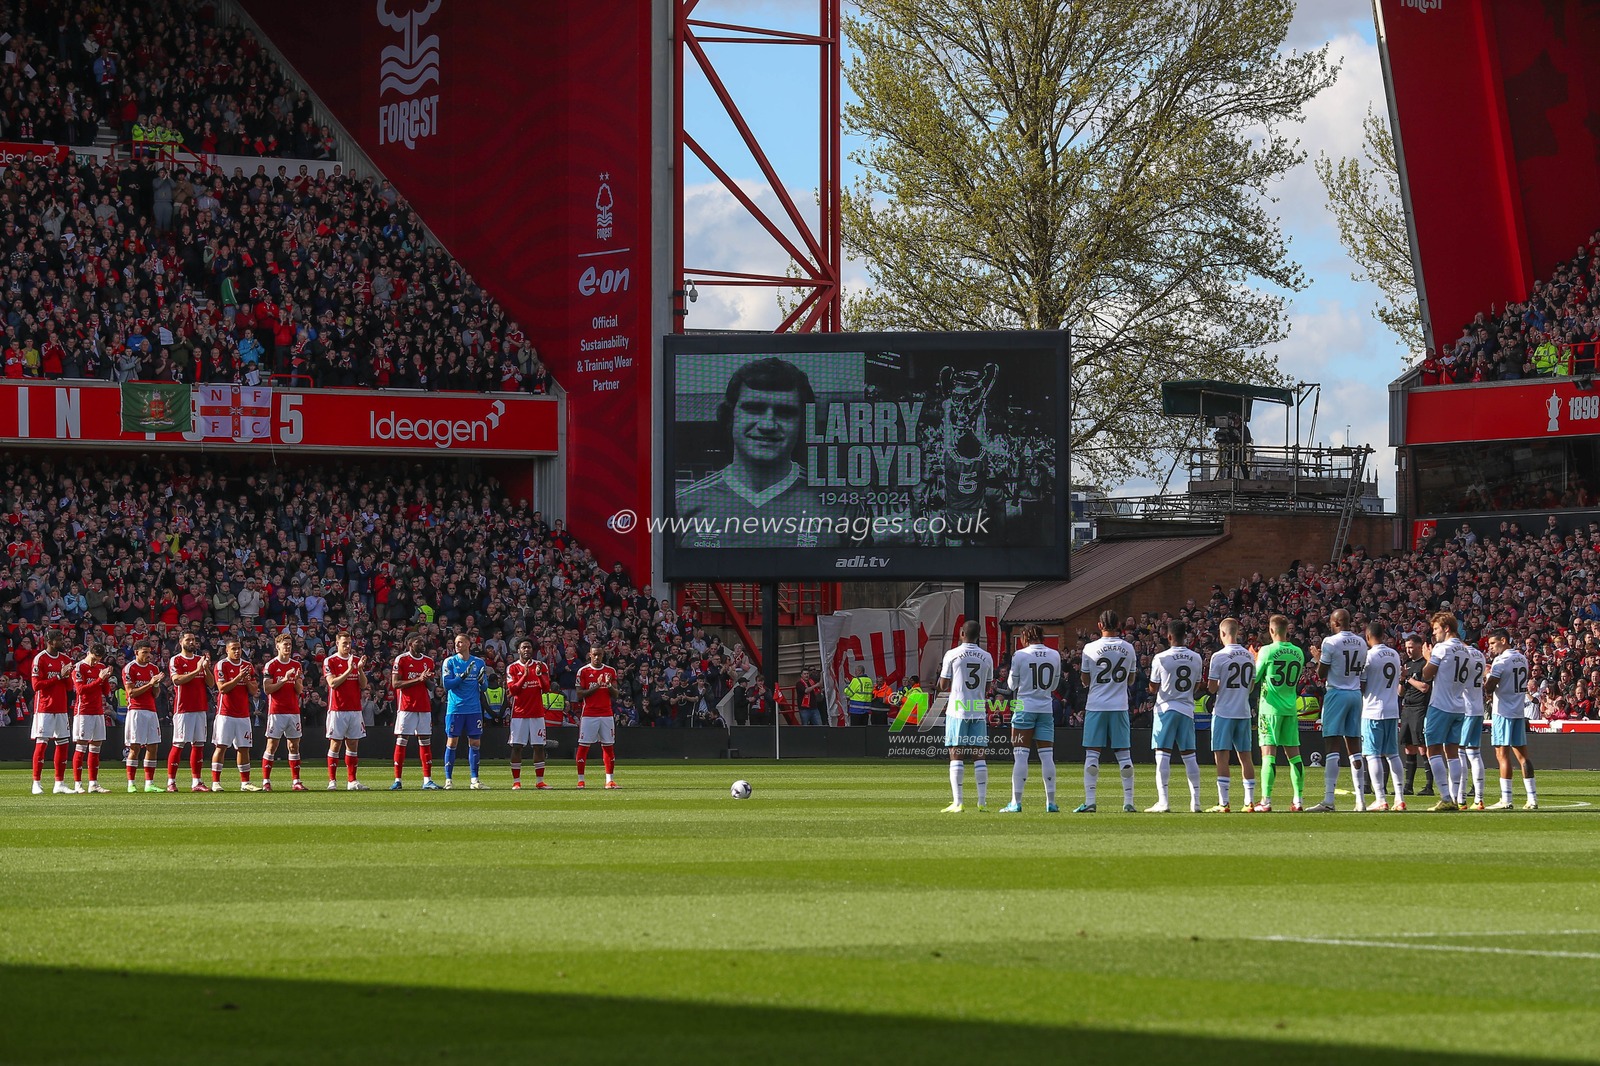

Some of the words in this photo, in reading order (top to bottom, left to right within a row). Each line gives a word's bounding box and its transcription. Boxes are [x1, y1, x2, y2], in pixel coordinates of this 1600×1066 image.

[592, 315, 618, 330] Official
[580, 335, 630, 352] Sustainability
[577, 361, 584, 373] &
[584, 358, 614, 373] Training
[614, 355, 633, 369] Wear
[593, 379, 620, 392] Partner
[1568, 395, 1600, 421] 1898
[370, 410, 488, 449] Ideagen
[805, 401, 924, 444] LARRY
[807, 445, 923, 487] LLOYD
[818, 492, 911, 505] 1948-2024
[835, 555, 891, 568] adi.tv
[959, 651, 988, 663] MITCHELL
[1096, 645, 1130, 657] RICHARDS
[1172, 653, 1194, 662] LERMA
[1272, 647, 1303, 661] HENDERSON
[1342, 650, 1363, 676] 14
[965, 663, 981, 690] 3
[1029, 662, 1055, 690] 10
[1096, 657, 1127, 684] 26
[1175, 665, 1192, 692] 8
[1226, 662, 1254, 689] 20
[1270, 660, 1302, 687] 30
[1383, 662, 1396, 689] 9
[1453, 656, 1470, 684] 16
[1473, 662, 1483, 688] 2
[1512, 667, 1527, 694] 12
